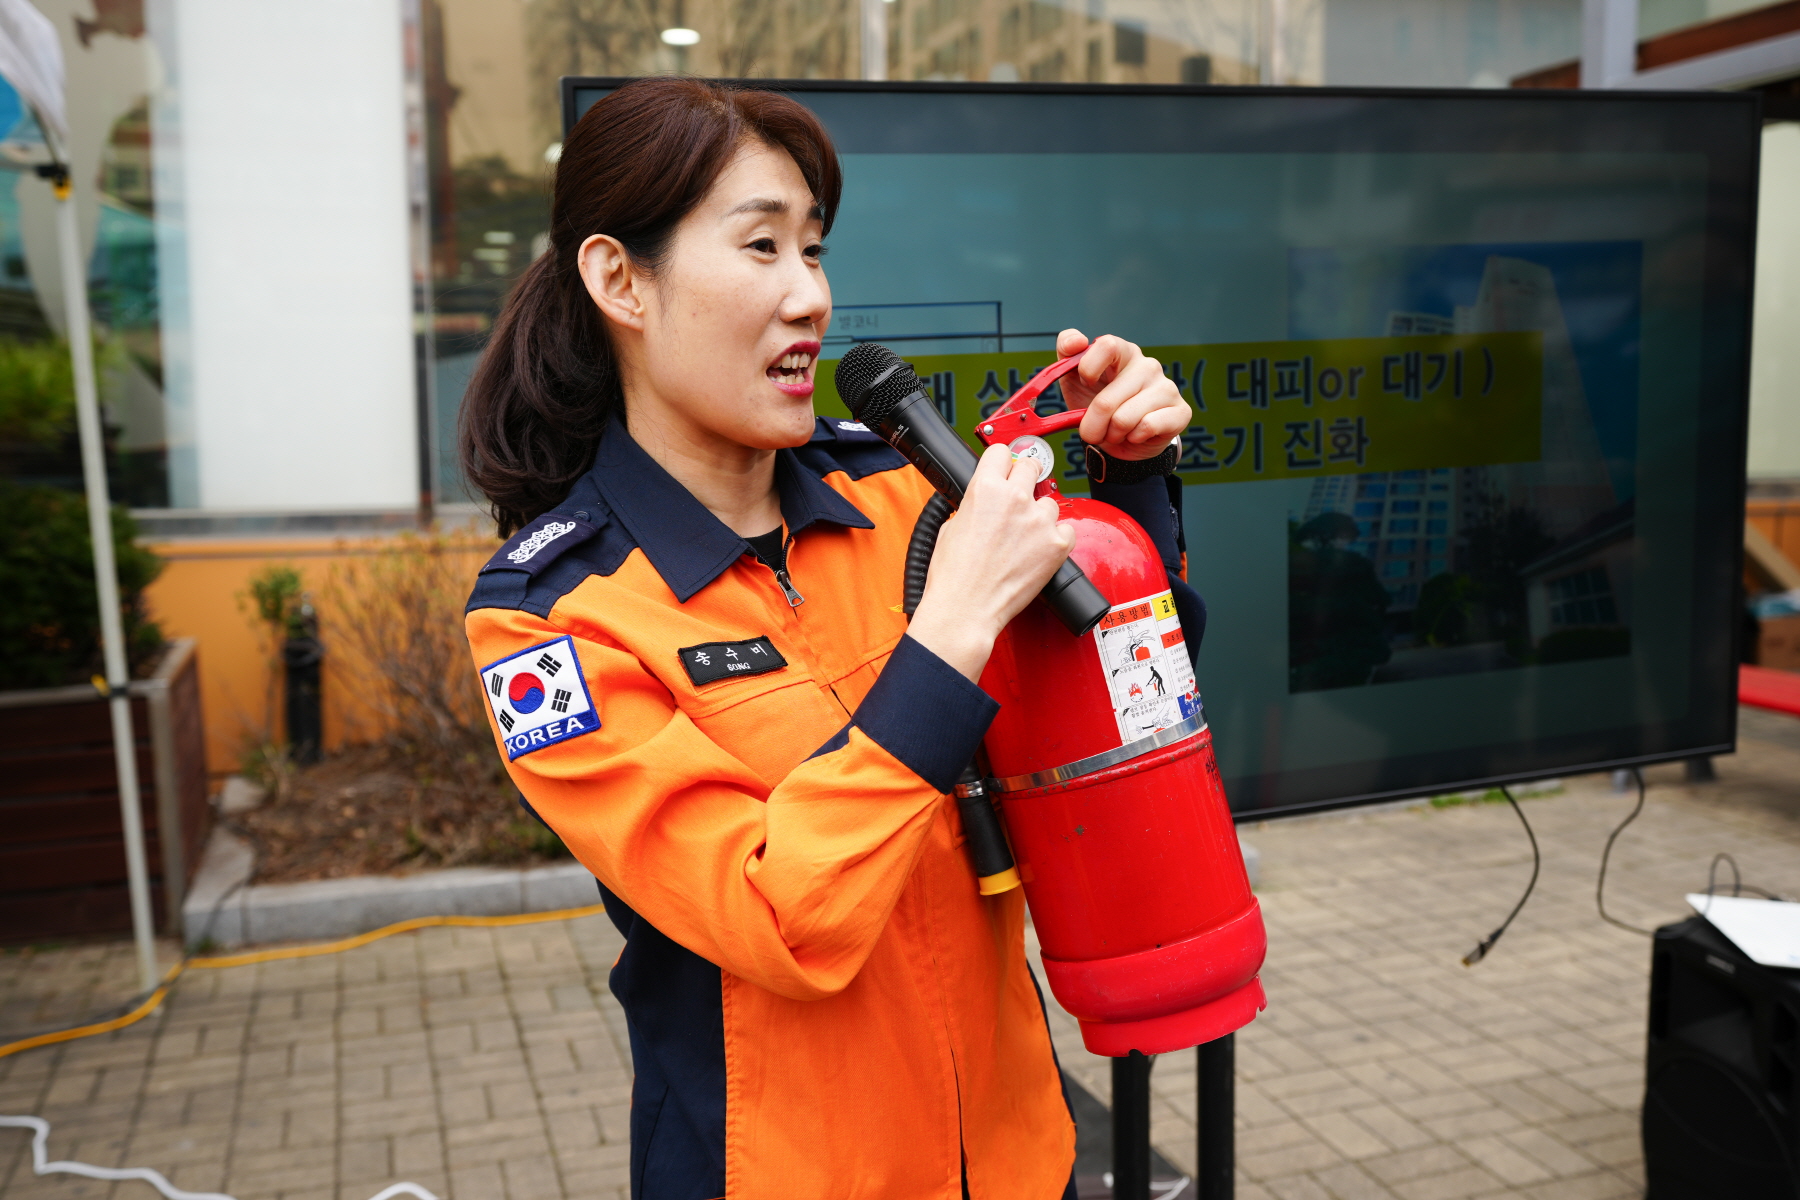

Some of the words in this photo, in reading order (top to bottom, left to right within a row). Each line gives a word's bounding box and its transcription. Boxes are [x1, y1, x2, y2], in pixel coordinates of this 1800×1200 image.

[1382, 349, 1464, 401] 대기
[1176, 420, 1264, 473] 초기
[1283, 416, 1371, 470] 진화
[1103, 603, 1150, 627] 사용방법
[726, 661, 752, 672] SONG
[504, 716, 585, 756] KOREA
